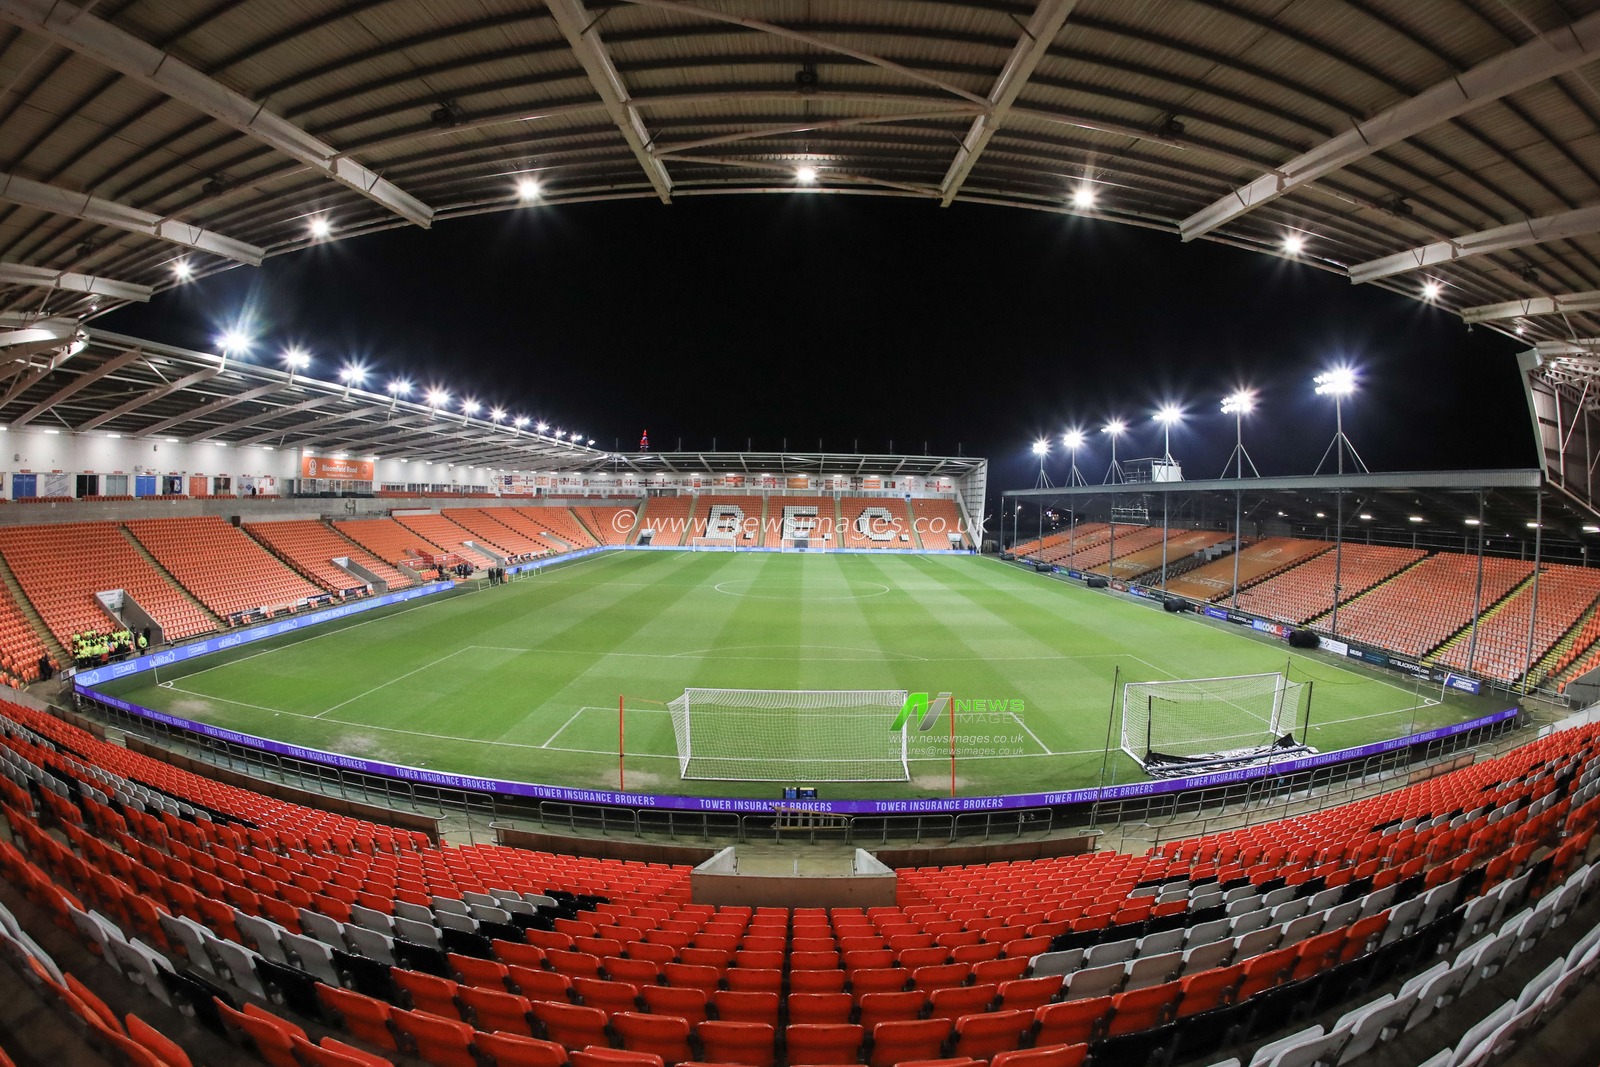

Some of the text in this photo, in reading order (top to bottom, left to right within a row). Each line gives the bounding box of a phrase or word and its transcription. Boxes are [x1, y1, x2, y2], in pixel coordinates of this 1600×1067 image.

[322, 464, 346, 472] Bloomfield
[120, 663, 136, 673] DAVE
[150, 656, 169, 667] utilita
[204, 726, 265, 748] TOWER INSURANCE BROKERS
[288, 747, 367, 770] TOWER INSURANCE BROKERS
[1295, 748, 1363, 768] TOWER INSURANCE BROKERS
[395, 768, 496, 790] TOWER INSURANCE BROKERS
[1186, 766, 1273, 787] TOWER INSURANCE BROKERS
[533, 787, 655, 806] TOWER INSURANCE BROKERS
[1044, 793, 1072, 803] TOWER
[1120, 784, 1154, 796] BROKERS
[700, 800, 832, 812] TOWER INSURANCE BROKERS
[876, 799, 1003, 811] TOWER INSURANCE BROKERS
